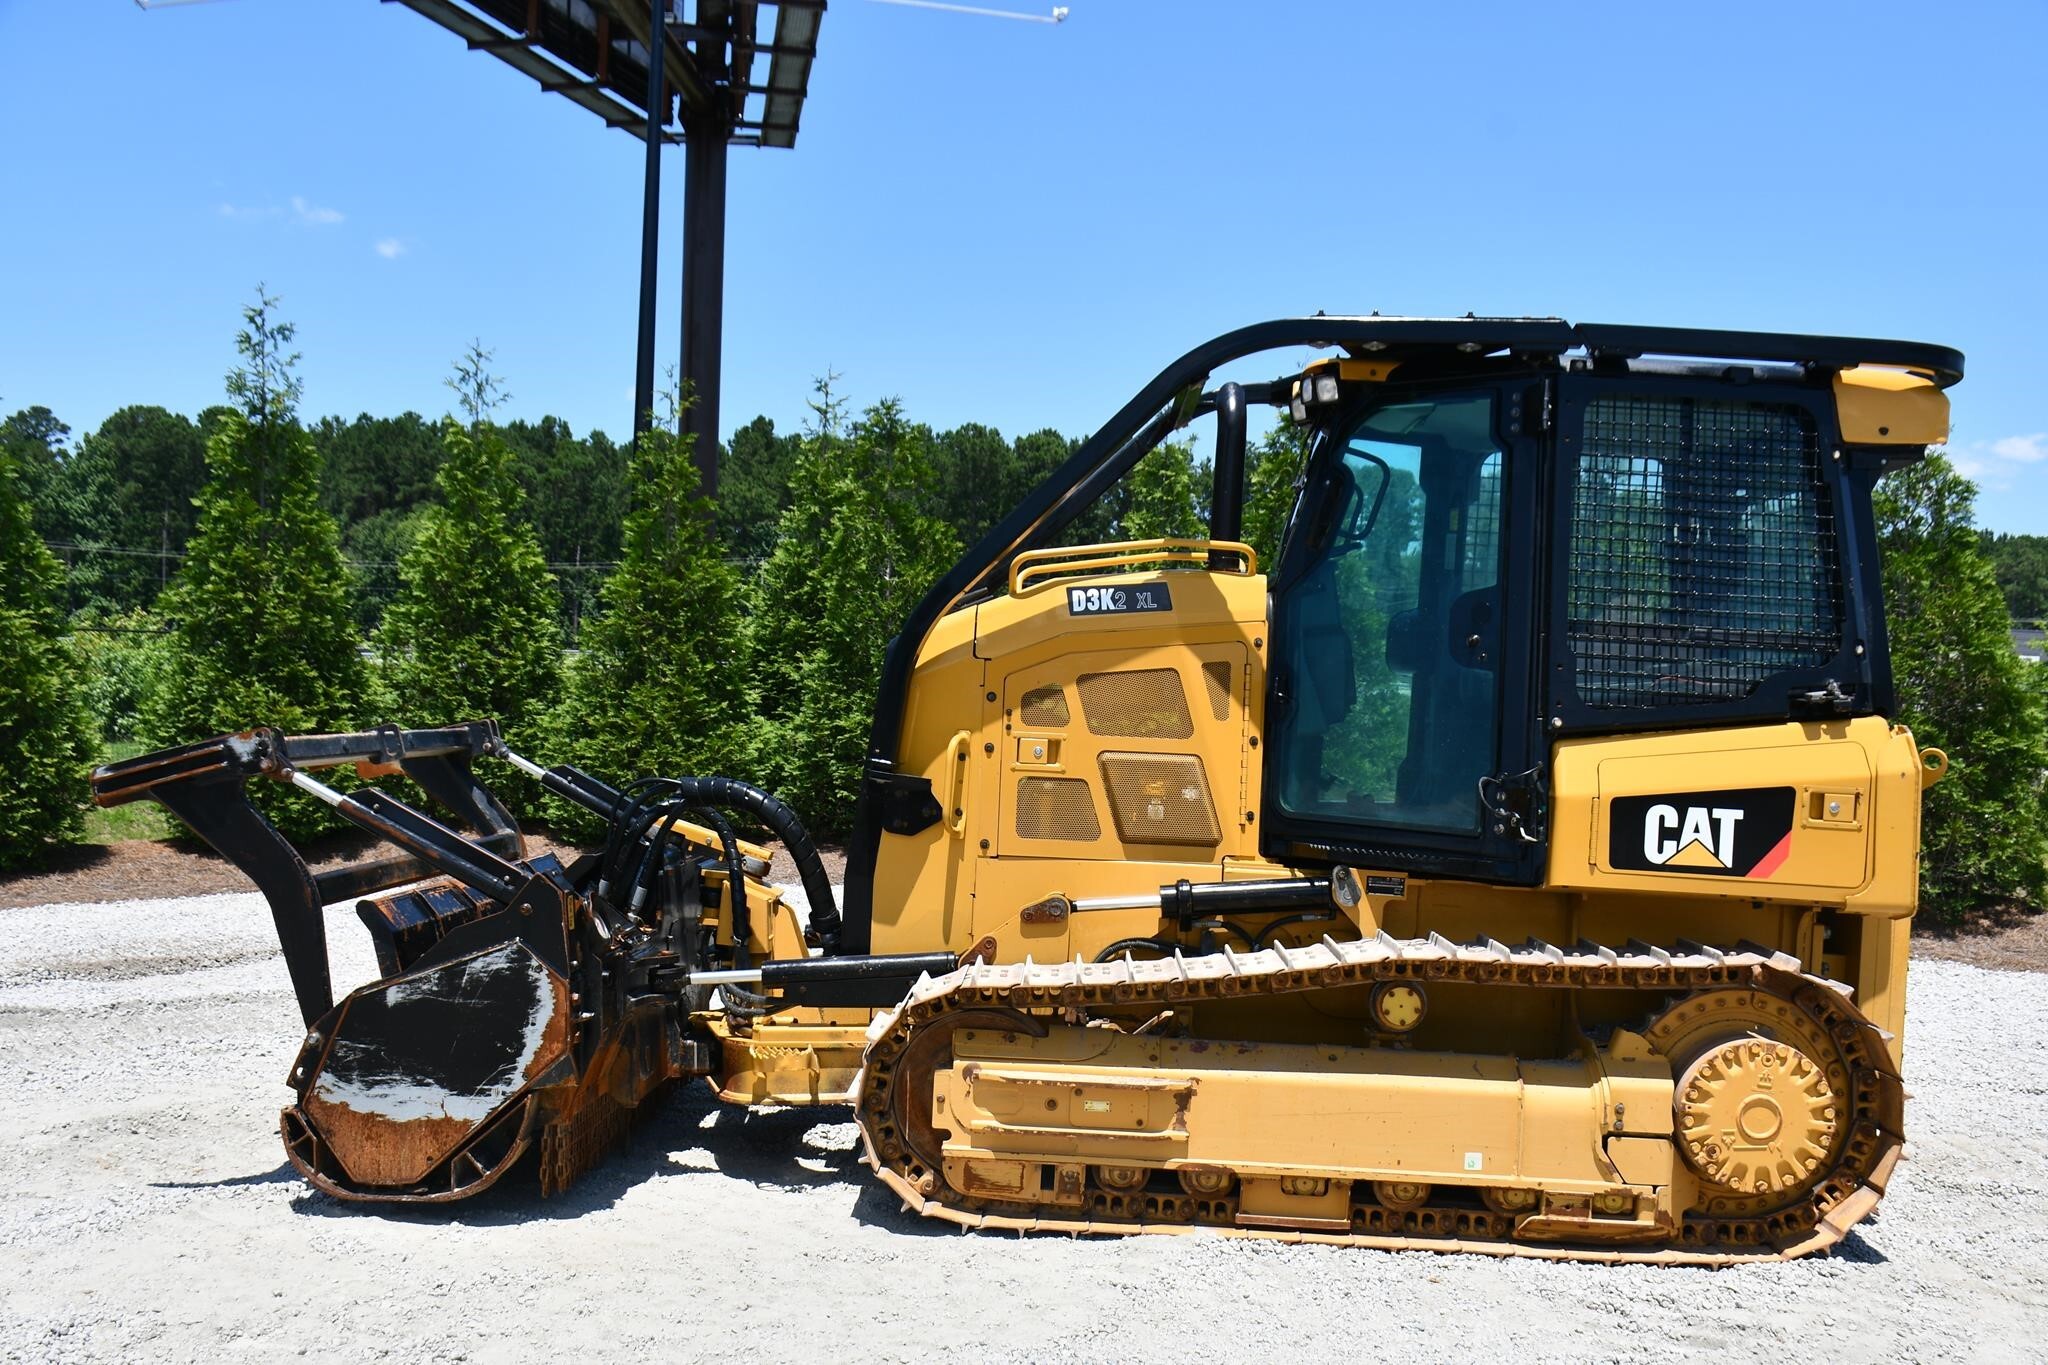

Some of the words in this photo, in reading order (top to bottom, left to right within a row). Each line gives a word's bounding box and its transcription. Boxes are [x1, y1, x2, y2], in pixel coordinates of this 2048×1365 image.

[1072, 588, 1126, 612] D3K2
[1136, 592, 1157, 608] XL
[1644, 804, 1744, 868] CAT
